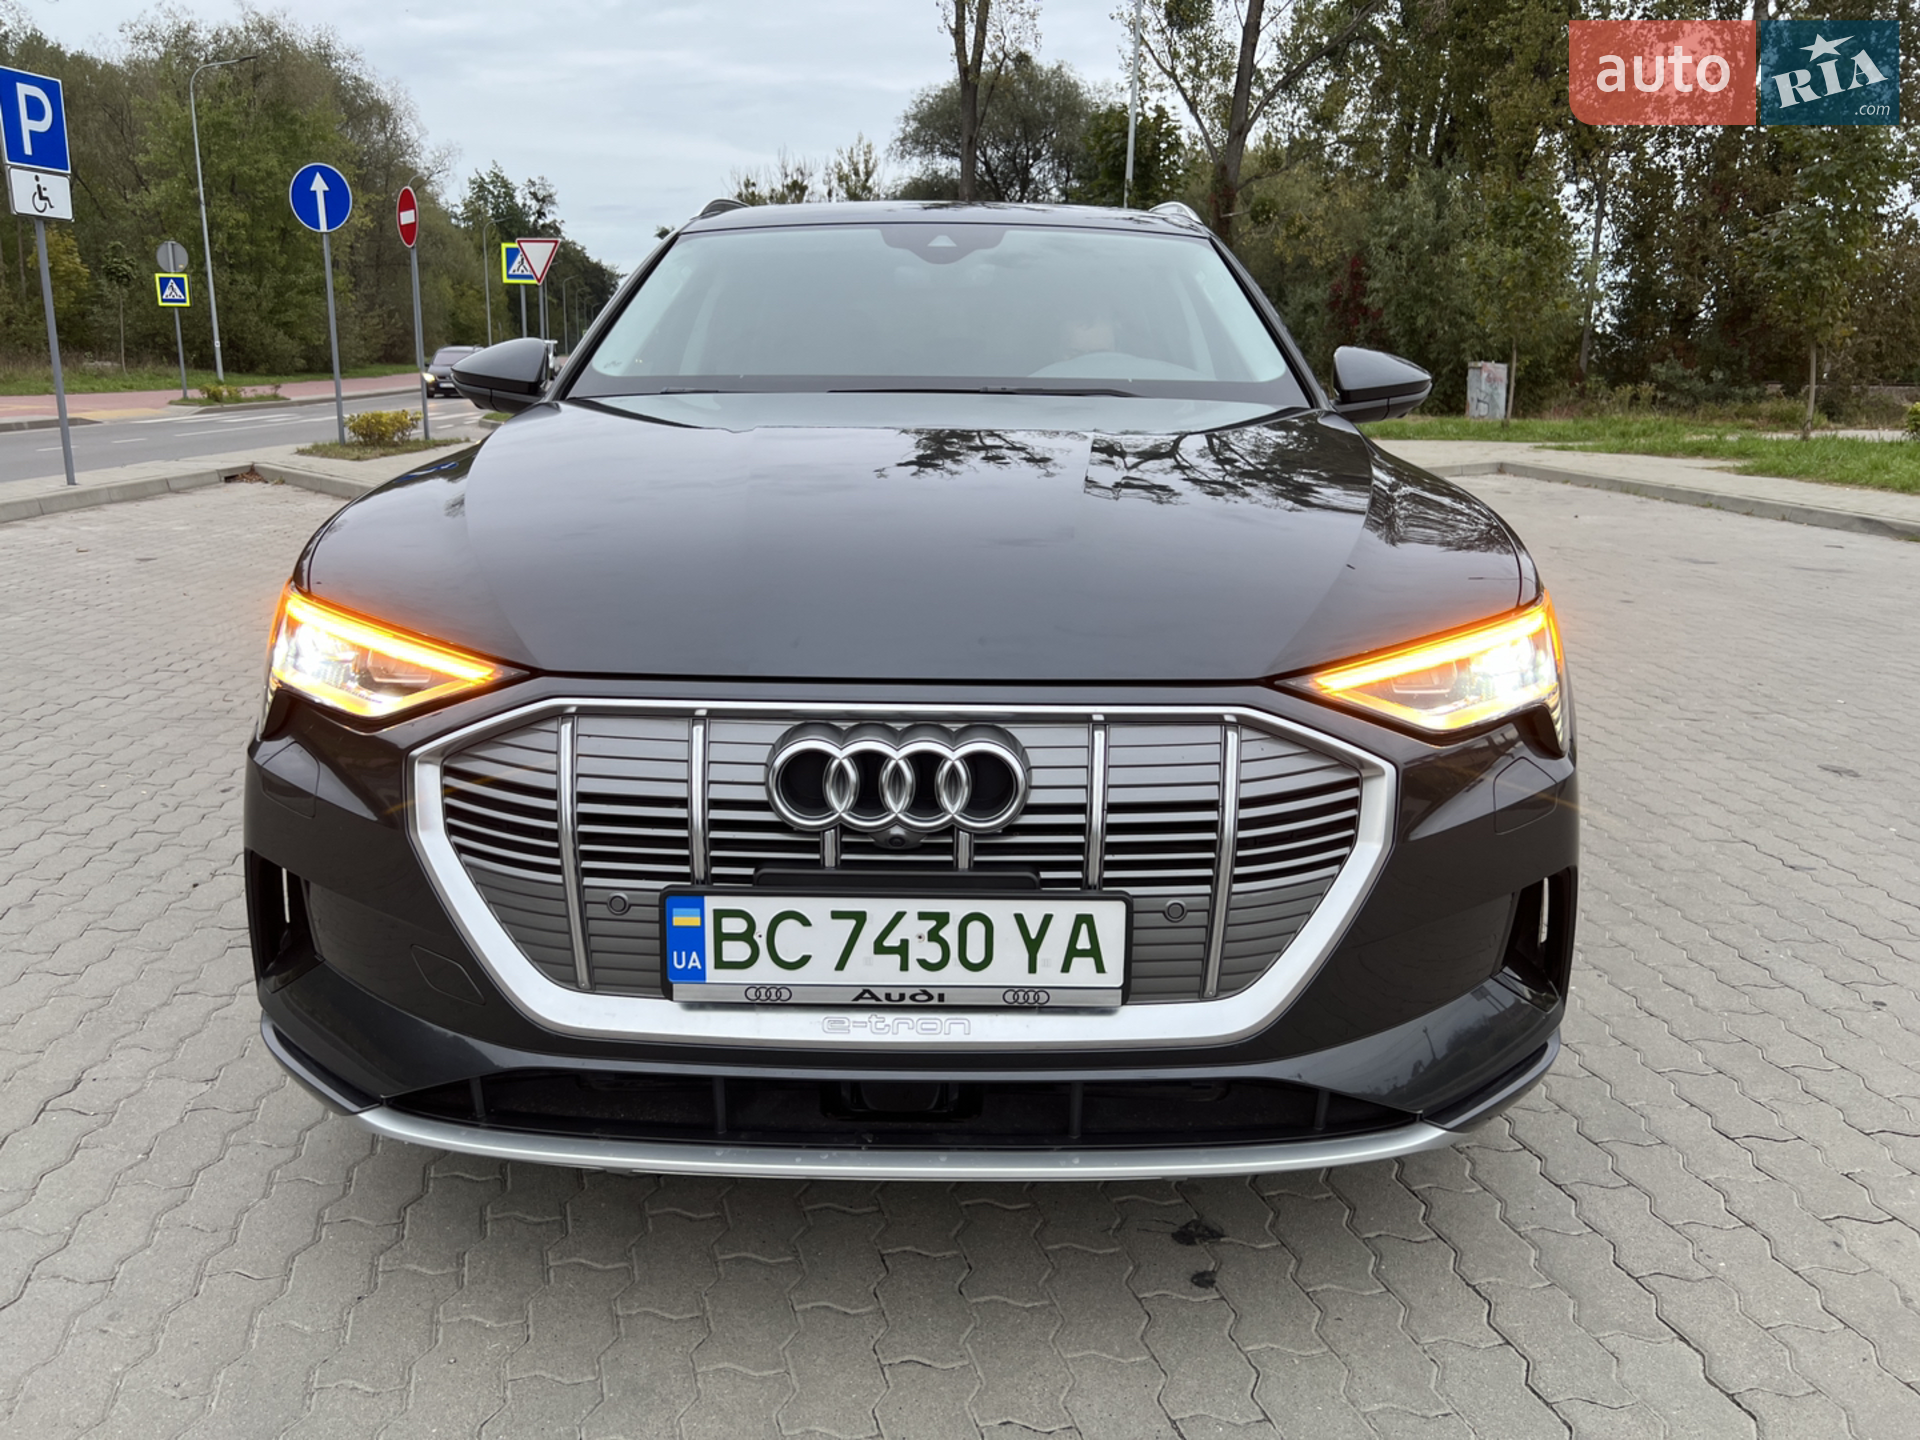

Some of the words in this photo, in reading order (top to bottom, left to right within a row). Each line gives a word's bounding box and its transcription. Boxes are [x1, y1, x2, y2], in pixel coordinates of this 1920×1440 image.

[17, 82, 52, 155] P
[713, 909, 812, 970] BC
[831, 910, 994, 971] 7430
[1013, 913, 1106, 974] YA
[673, 951, 701, 969] UA
[852, 988, 945, 1003] Audi
[822, 1014, 971, 1036] e-tron
